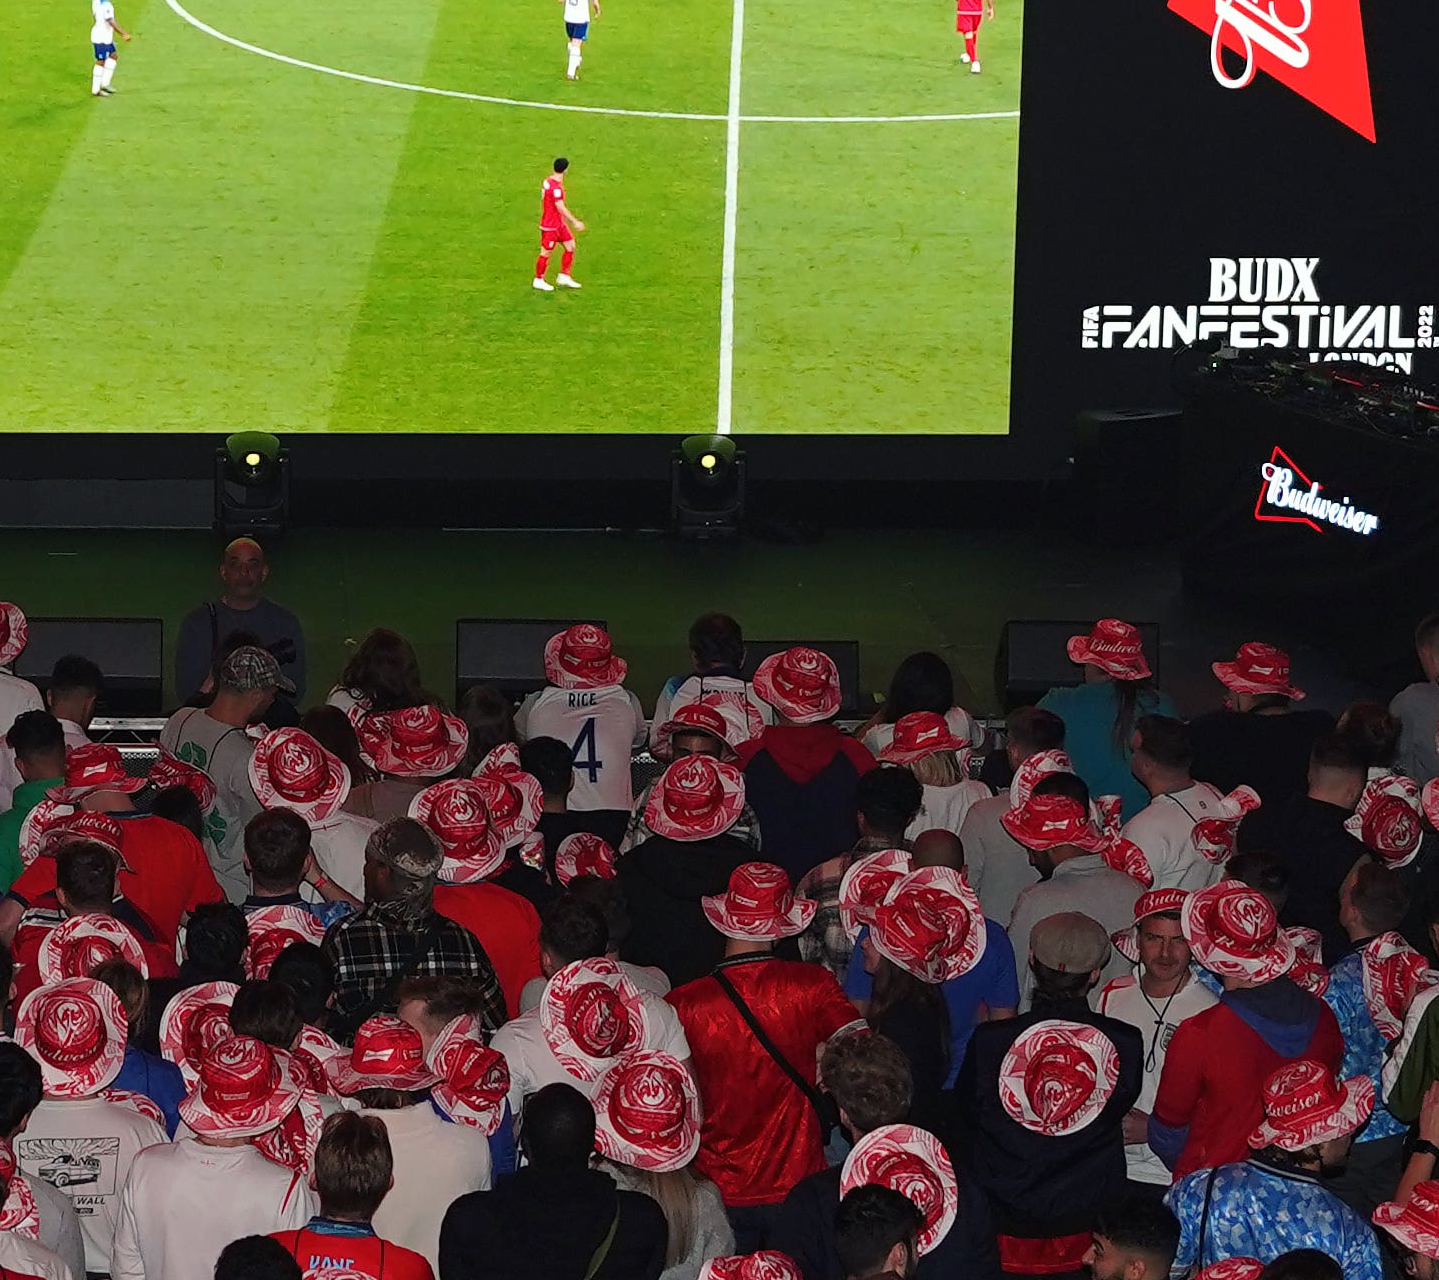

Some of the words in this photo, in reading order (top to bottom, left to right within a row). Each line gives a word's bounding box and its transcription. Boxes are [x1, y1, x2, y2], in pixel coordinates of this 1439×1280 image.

[1208, 257, 1320, 303] BUDX
[1082, 305, 1100, 349] FIFA
[1417, 304, 1434, 349] 2022
[1262, 462, 1378, 535] Budweiser
[568, 692, 596, 708] RICE
[571, 717, 603, 783] 4
